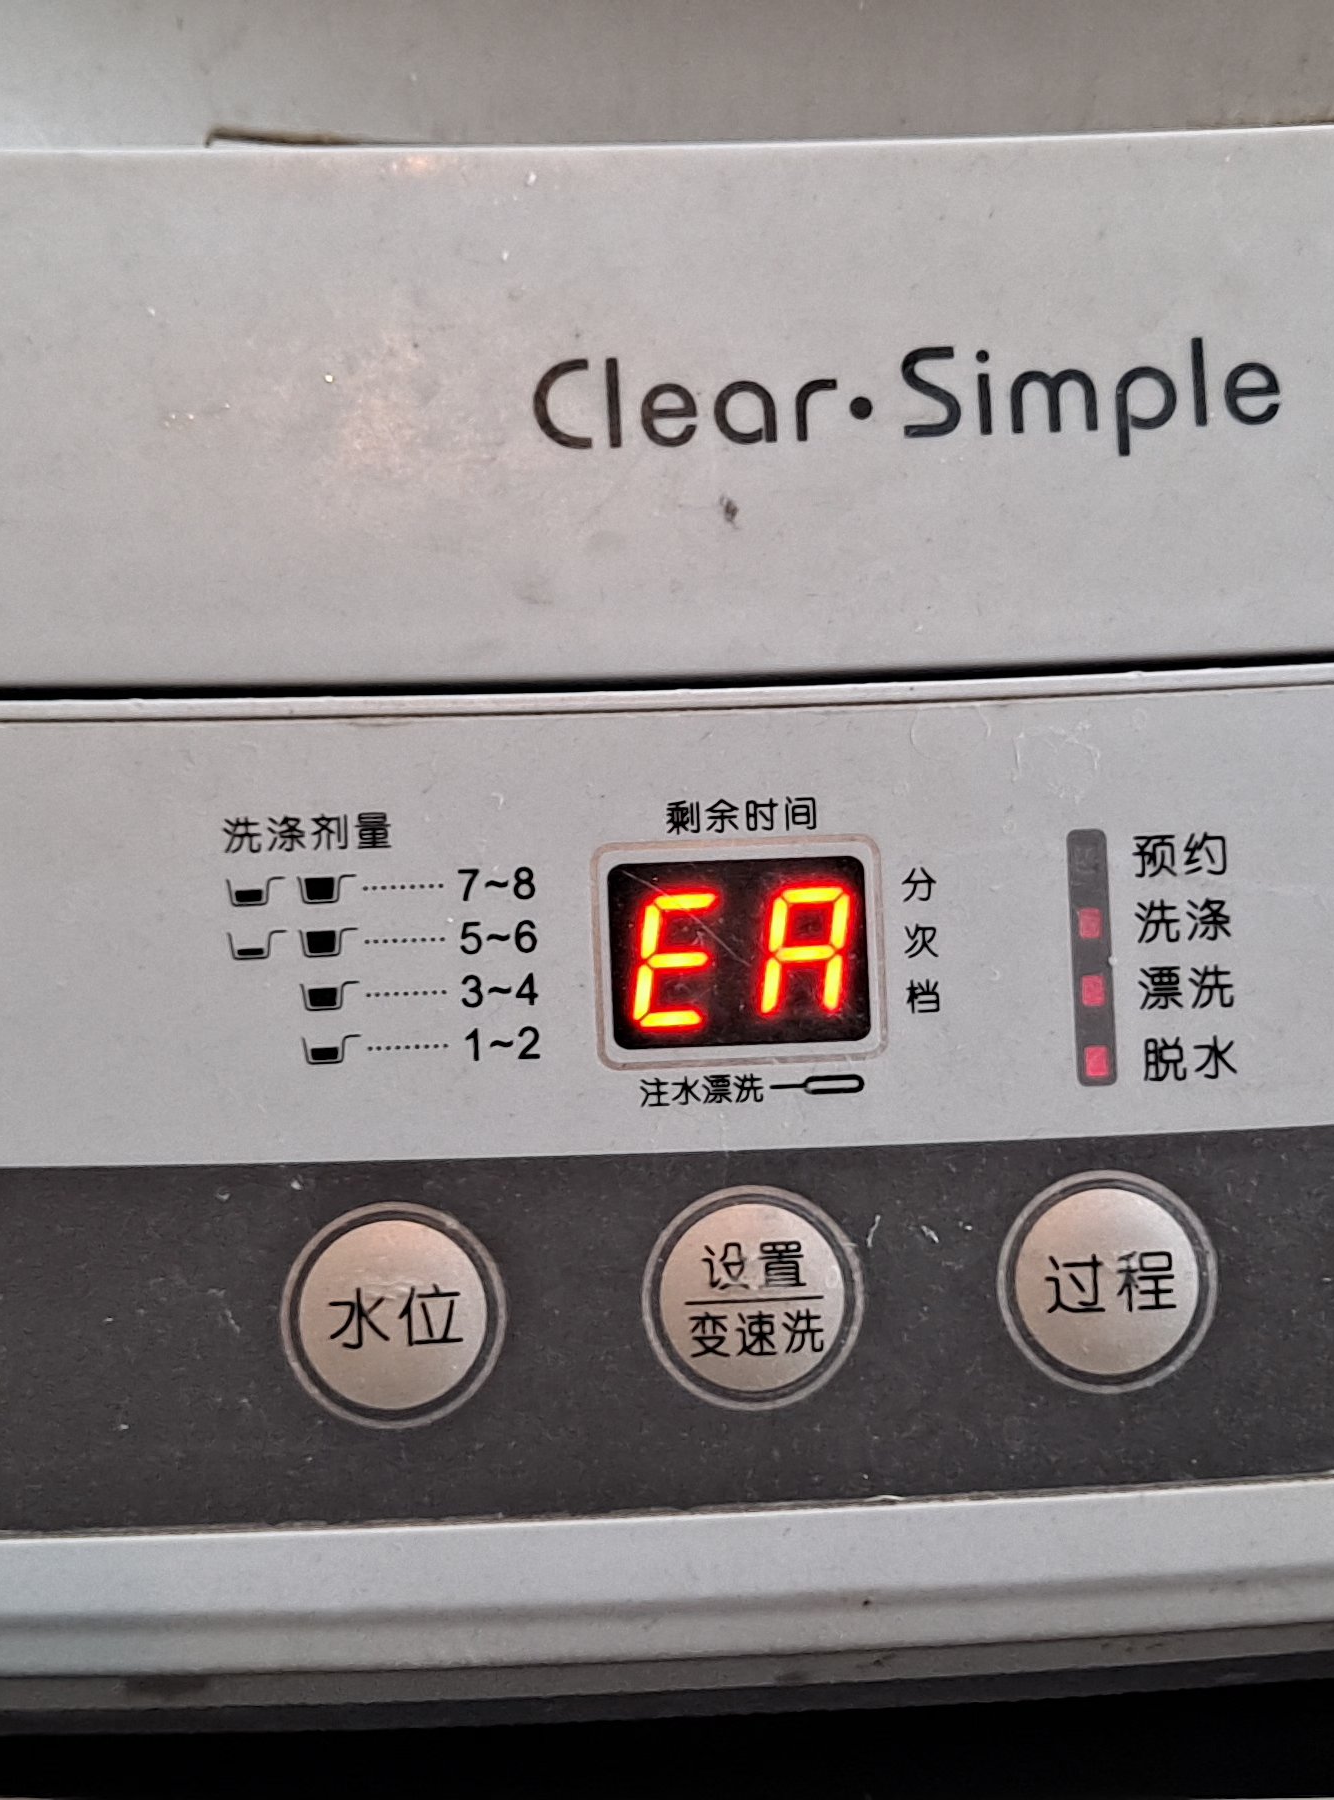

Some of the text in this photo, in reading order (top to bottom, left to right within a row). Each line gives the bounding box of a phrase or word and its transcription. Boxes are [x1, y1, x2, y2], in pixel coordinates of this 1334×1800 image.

[224, 813, 391, 853] 洗涤剂量
[667, 797, 816, 834] 剩余时间
[1133, 832, 1226, 877] 预约
[458, 867, 535, 901] 7~8
[902, 868, 936, 901] 分
[461, 920, 537, 954] 5~6
[1135, 899, 1230, 943] 洗涤
[905, 924, 938, 958] 次
[462, 973, 538, 1008] 3~4
[907, 980, 939, 1013] 档
[1139, 966, 1233, 1009] 漂洗
[466, 1026, 540, 1061] 1~2
[1145, 1036, 1236, 1081] 脱水
[641, 1074, 763, 1106] 注水漂洗
[703, 1240, 807, 1290] 设置
[1045, 1252, 1176, 1313] 过程
[329, 1285, 463, 1349] 水位
[689, 1309, 825, 1359] 变速洗
